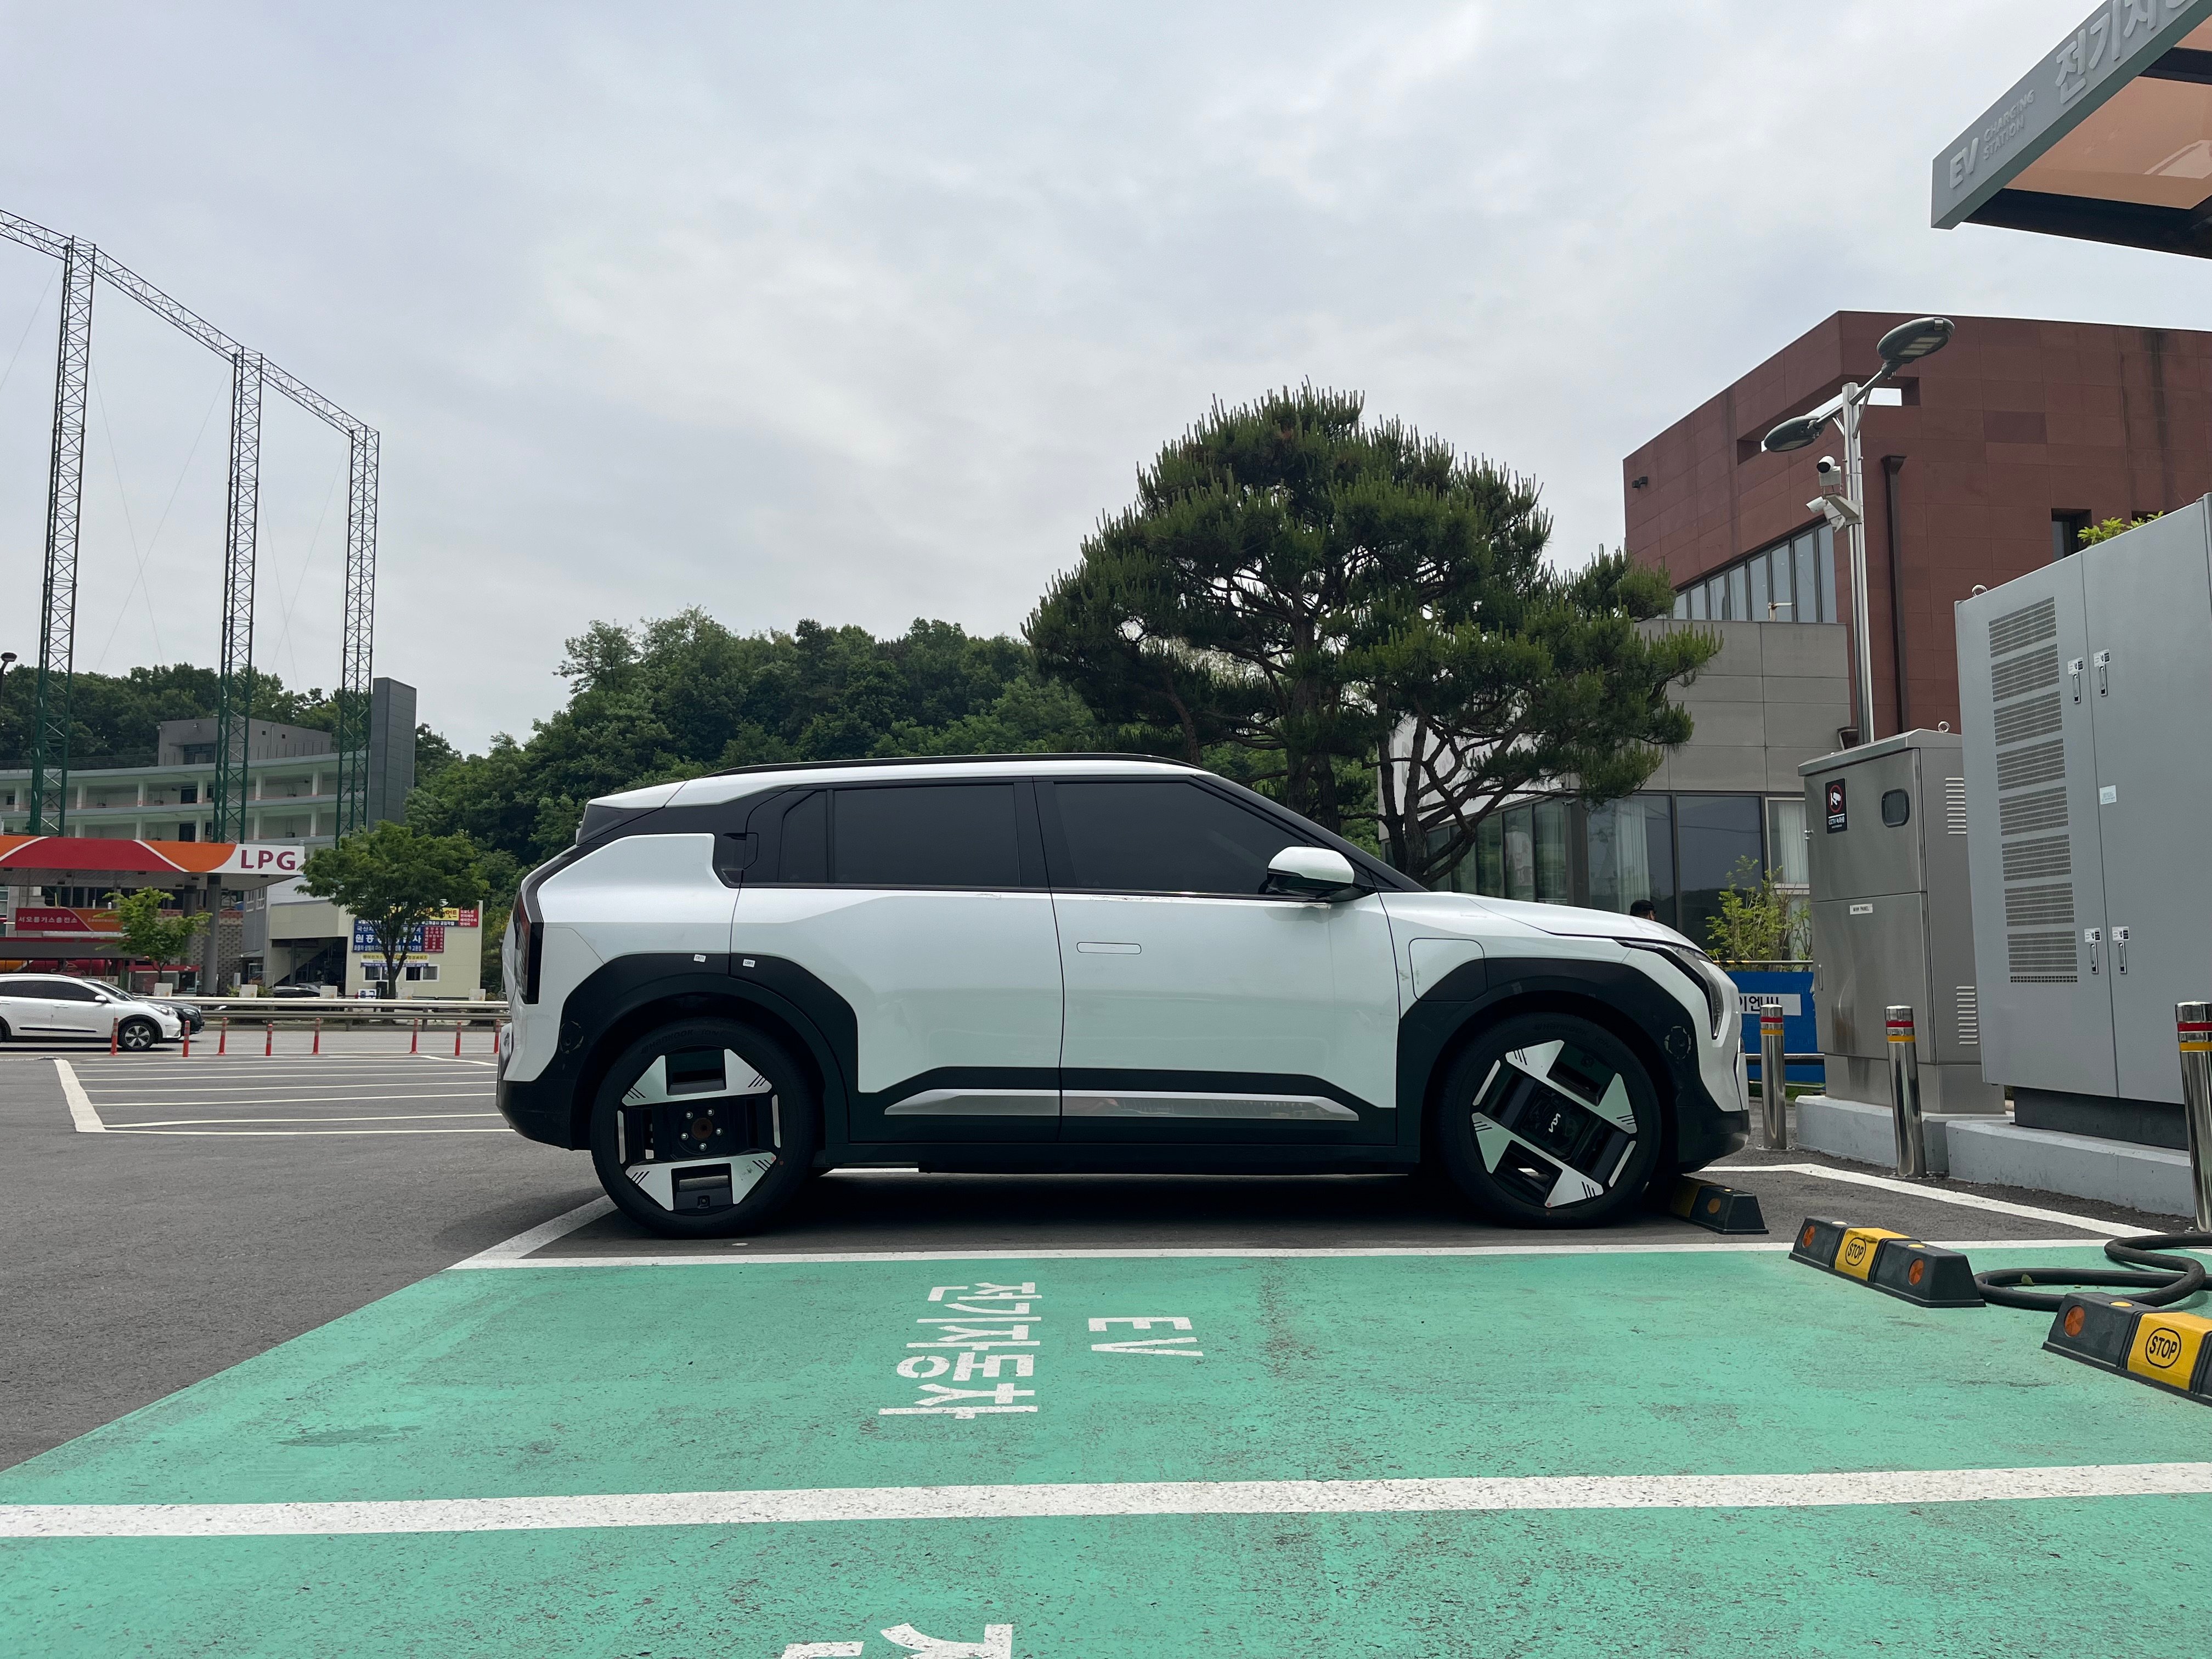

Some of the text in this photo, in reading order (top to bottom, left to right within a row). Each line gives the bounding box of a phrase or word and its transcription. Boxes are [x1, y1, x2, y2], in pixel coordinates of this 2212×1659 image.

[1983, 114, 2024, 160] STATION
[1984, 89, 2034, 142] CHARGING
[1950, 137, 1979, 189] EV
[241, 850, 295, 871] LPG
[1848, 1243, 1864, 1260] STOP
[878, 1282, 1042, 1419] 전기자동차
[1088, 1317, 1204, 1357] EV
[2149, 1335, 2177, 1359] STOP
